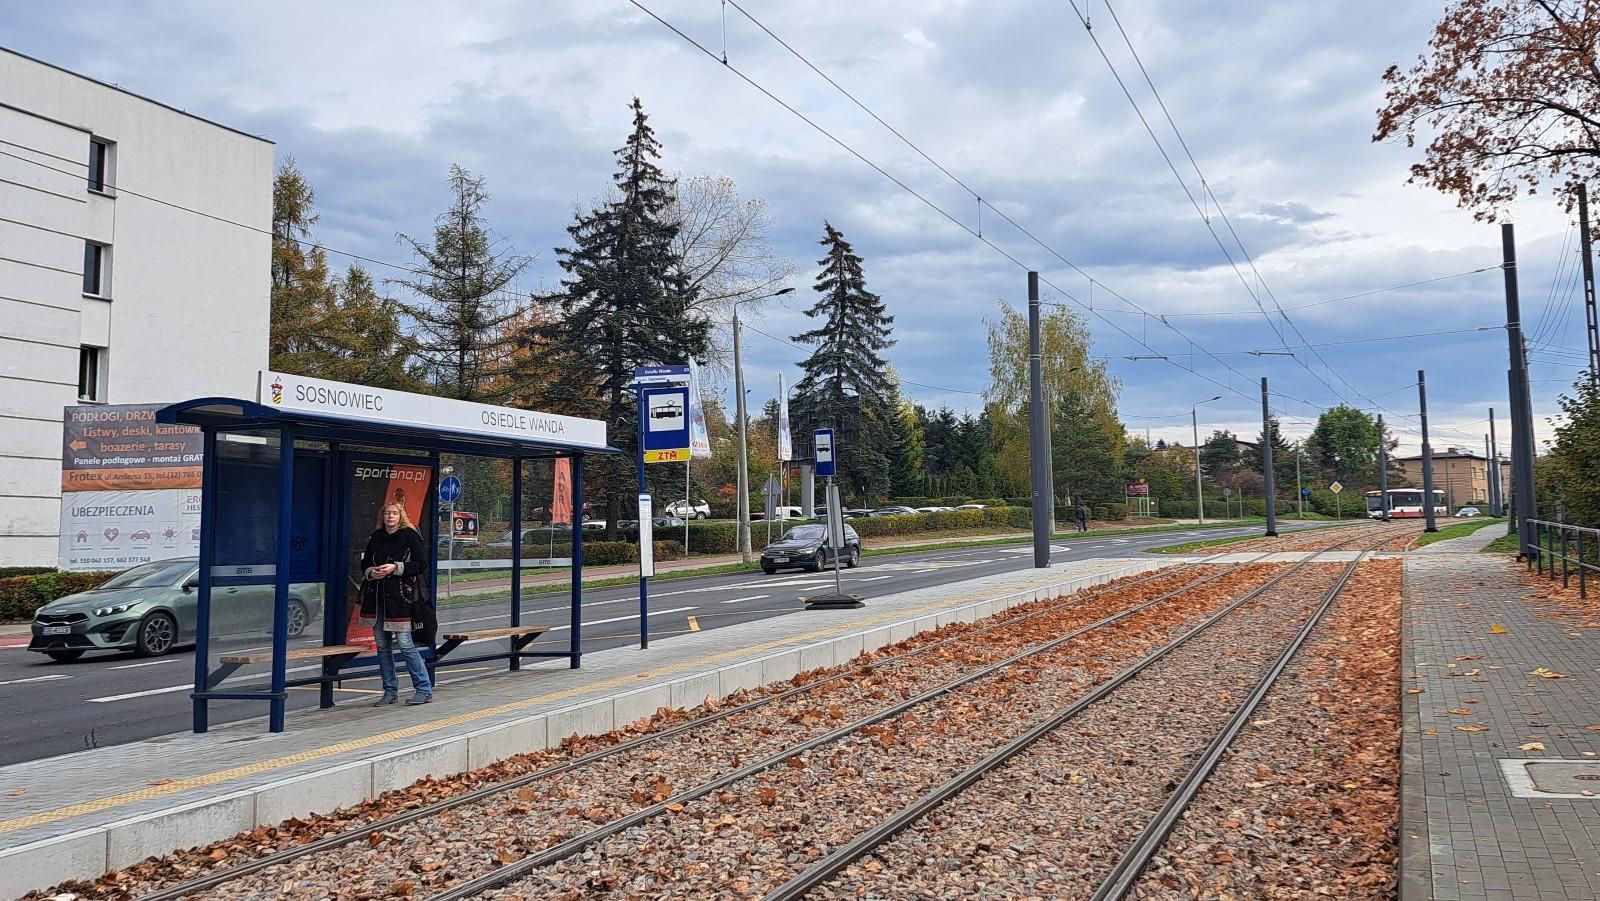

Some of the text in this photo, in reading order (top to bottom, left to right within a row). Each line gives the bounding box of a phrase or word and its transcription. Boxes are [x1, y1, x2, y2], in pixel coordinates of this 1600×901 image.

[296, 384, 383, 411] SOSNOWIEC
[71, 410, 122, 423] PODŁOGI,
[481, 410, 565, 434] OSIEDLE WANDA
[83, 427, 119, 439] Listwy,
[122, 425, 152, 437] deski,
[100, 442, 145, 453] boazerie
[154, 441, 186, 452] tarasy
[74, 457, 100, 466] Panele
[102, 455, 145, 466] podłogowe
[152, 454, 181, 464] montaż
[182, 453, 204, 462] GRAT
[657, 450, 677, 460] ZTM
[69, 471, 102, 482] Frotex
[354, 466, 426, 484] sportano.pl
[71, 505, 155, 518] UBEZPIECZENIA
